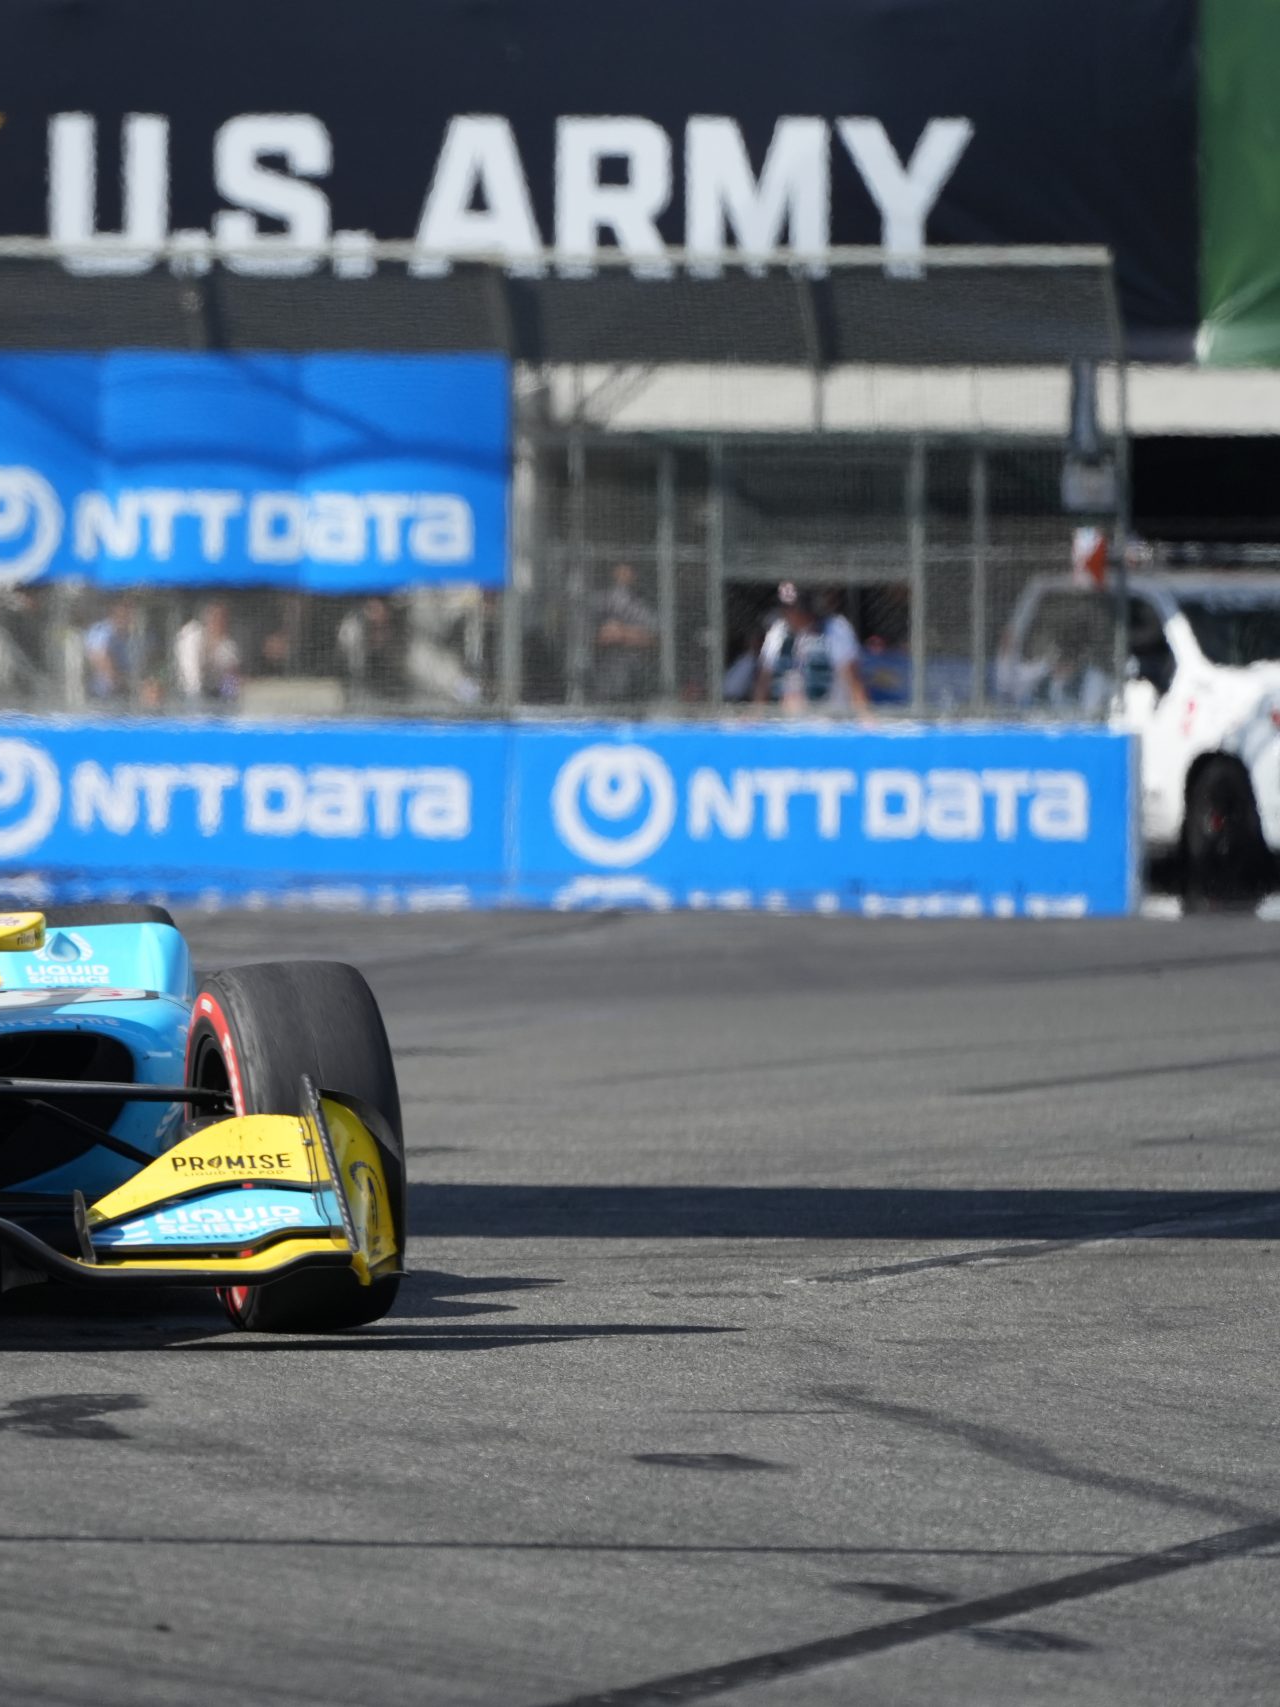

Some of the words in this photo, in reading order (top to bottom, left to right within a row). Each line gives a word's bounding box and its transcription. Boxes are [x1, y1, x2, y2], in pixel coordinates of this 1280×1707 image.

[46, 111, 378, 279] U.S.
[407, 113, 975, 281] ARMY
[75, 488, 241, 562] NTT
[71, 760, 240, 838] NTT
[687, 766, 856, 841] NTT
[25, 964, 110, 976] LIQUID
[28, 975, 111, 985] SCIENCE
[171, 1152, 293, 1172] PROMISE
[154, 1204, 302, 1225] LIQUID
[157, 1215, 304, 1235] SCIENCE
